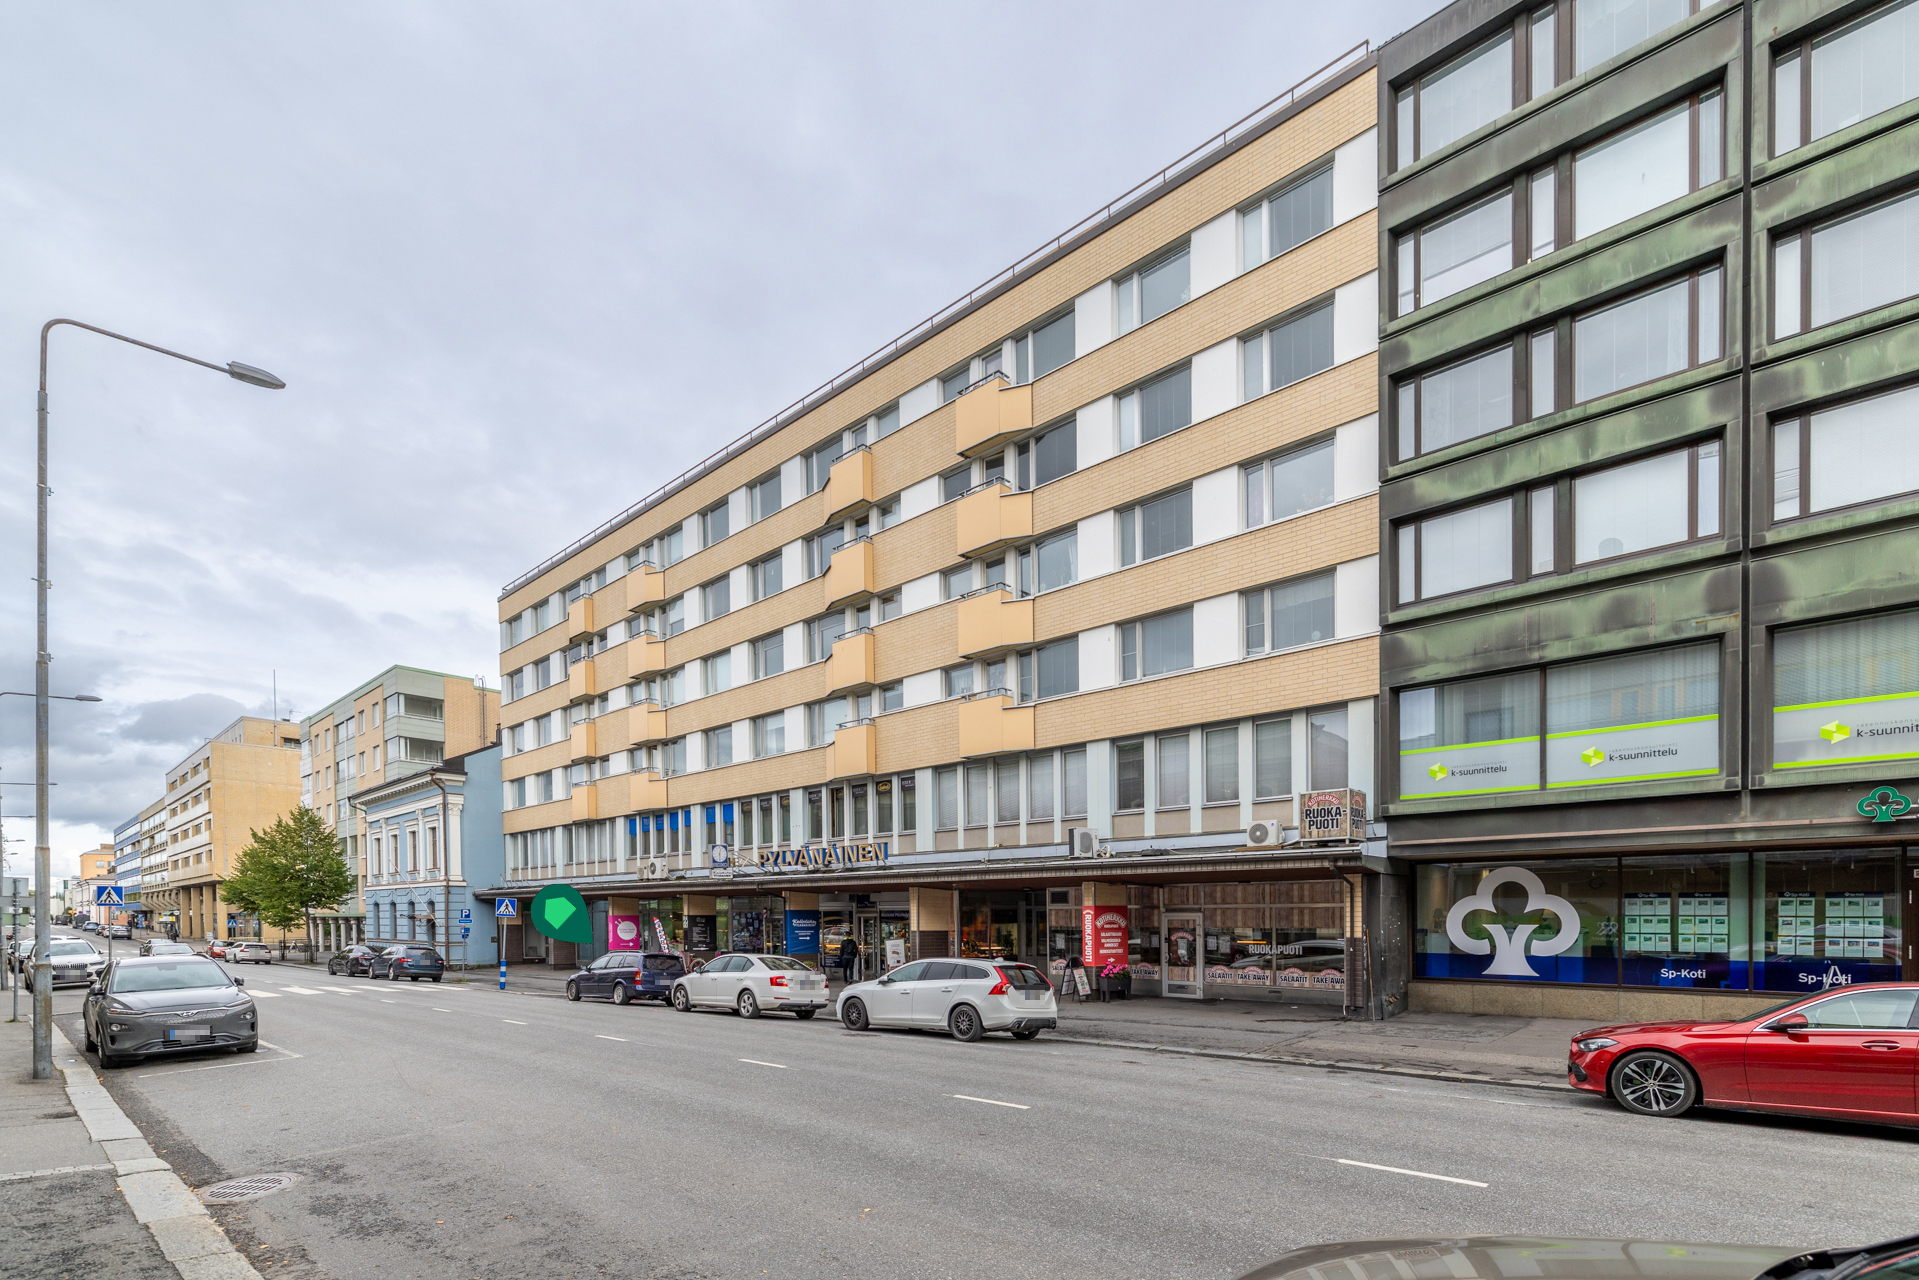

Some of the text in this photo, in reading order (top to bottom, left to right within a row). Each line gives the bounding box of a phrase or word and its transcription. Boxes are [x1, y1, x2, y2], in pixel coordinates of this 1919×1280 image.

[1608, 747, 1678, 762] k-suunnittelu
[1451, 765, 1507, 777] k-suunnittelu
[1307, 794, 1341, 807] KOTIHERKKU
[1305, 807, 1347, 819] RUOKA-
[1308, 818, 1339, 830] PUOTI
[757, 842, 888, 869] PYLVÄNÄINEN
[462, 909, 469, 918] P
[1084, 914, 1093, 962] RUOKAPUOTI
[1248, 944, 1303, 955] RUOKAPUOTI
[1252, 973, 1270, 981] AWAY
[1280, 975, 1308, 983] SALAATIT
[1313, 976, 1328, 984] TAKE
[1660, 968, 1706, 979] Sp-Koti
